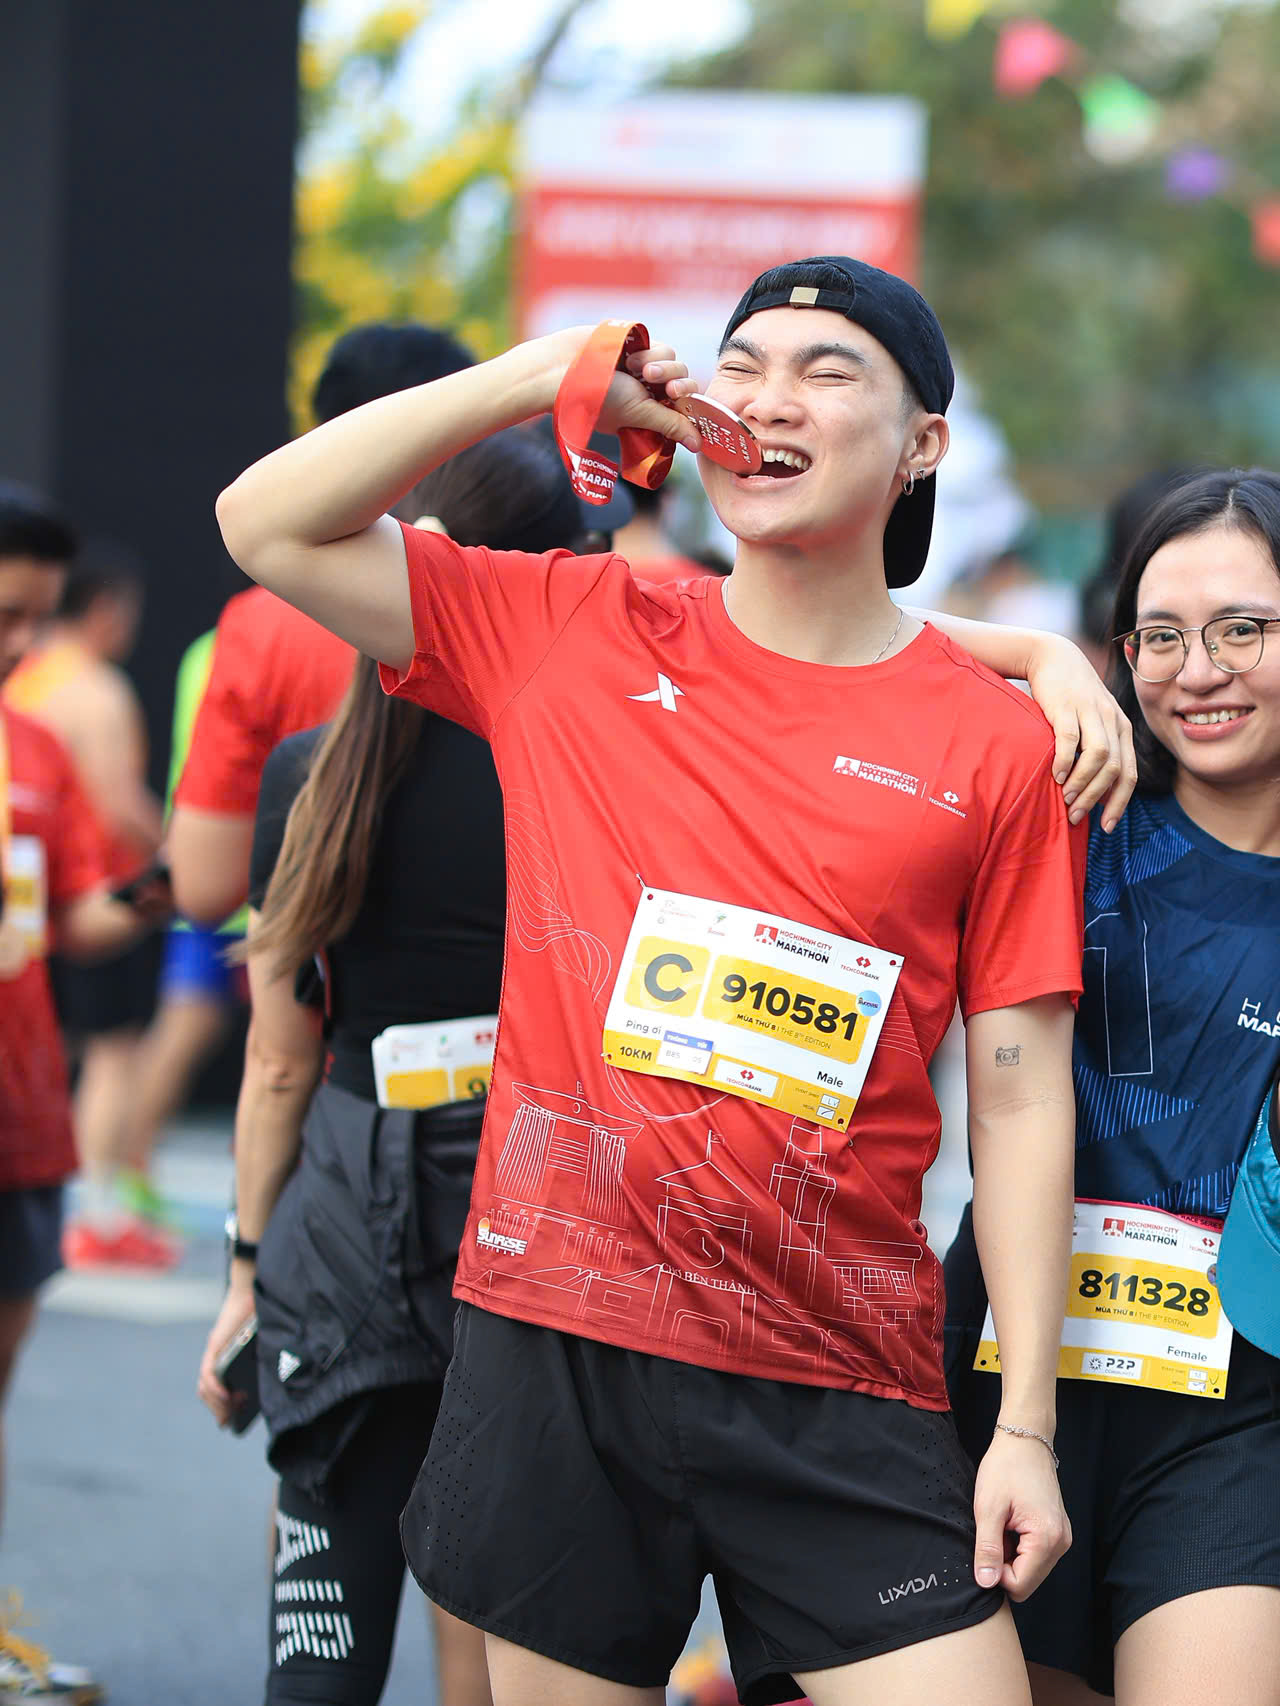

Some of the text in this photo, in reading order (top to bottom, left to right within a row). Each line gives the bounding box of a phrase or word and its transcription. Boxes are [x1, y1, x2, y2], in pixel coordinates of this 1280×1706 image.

[861, 761, 920, 783] HOCHIMINH CITY
[858, 771, 917, 796] MARATHON
[779, 929, 833, 951] HOCHIMINH CITY
[776, 939, 830, 965] MARATHON
[644, 953, 694, 1003] C
[840, 964, 880, 981] TECHCOMBANK
[721, 973, 859, 1042] 910581
[626, 1019, 649, 1034] Ping
[781, 1026, 794, 1037] THE
[804, 1035, 832, 1049] EDITION
[620, 1045, 652, 1061] 10KM
[816, 1070, 844, 1088] Male
[1124, 1230, 1178, 1247] MARATHON
[1164, 1225, 1180, 1234] CITY
[1078, 1269, 1211, 1317] 811328
[1138, 1311, 1152, 1320] THE
[1163, 1316, 1190, 1328] EDITION
[1167, 1345, 1208, 1362] Female
[1105, 1357, 1136, 1370] P2P
